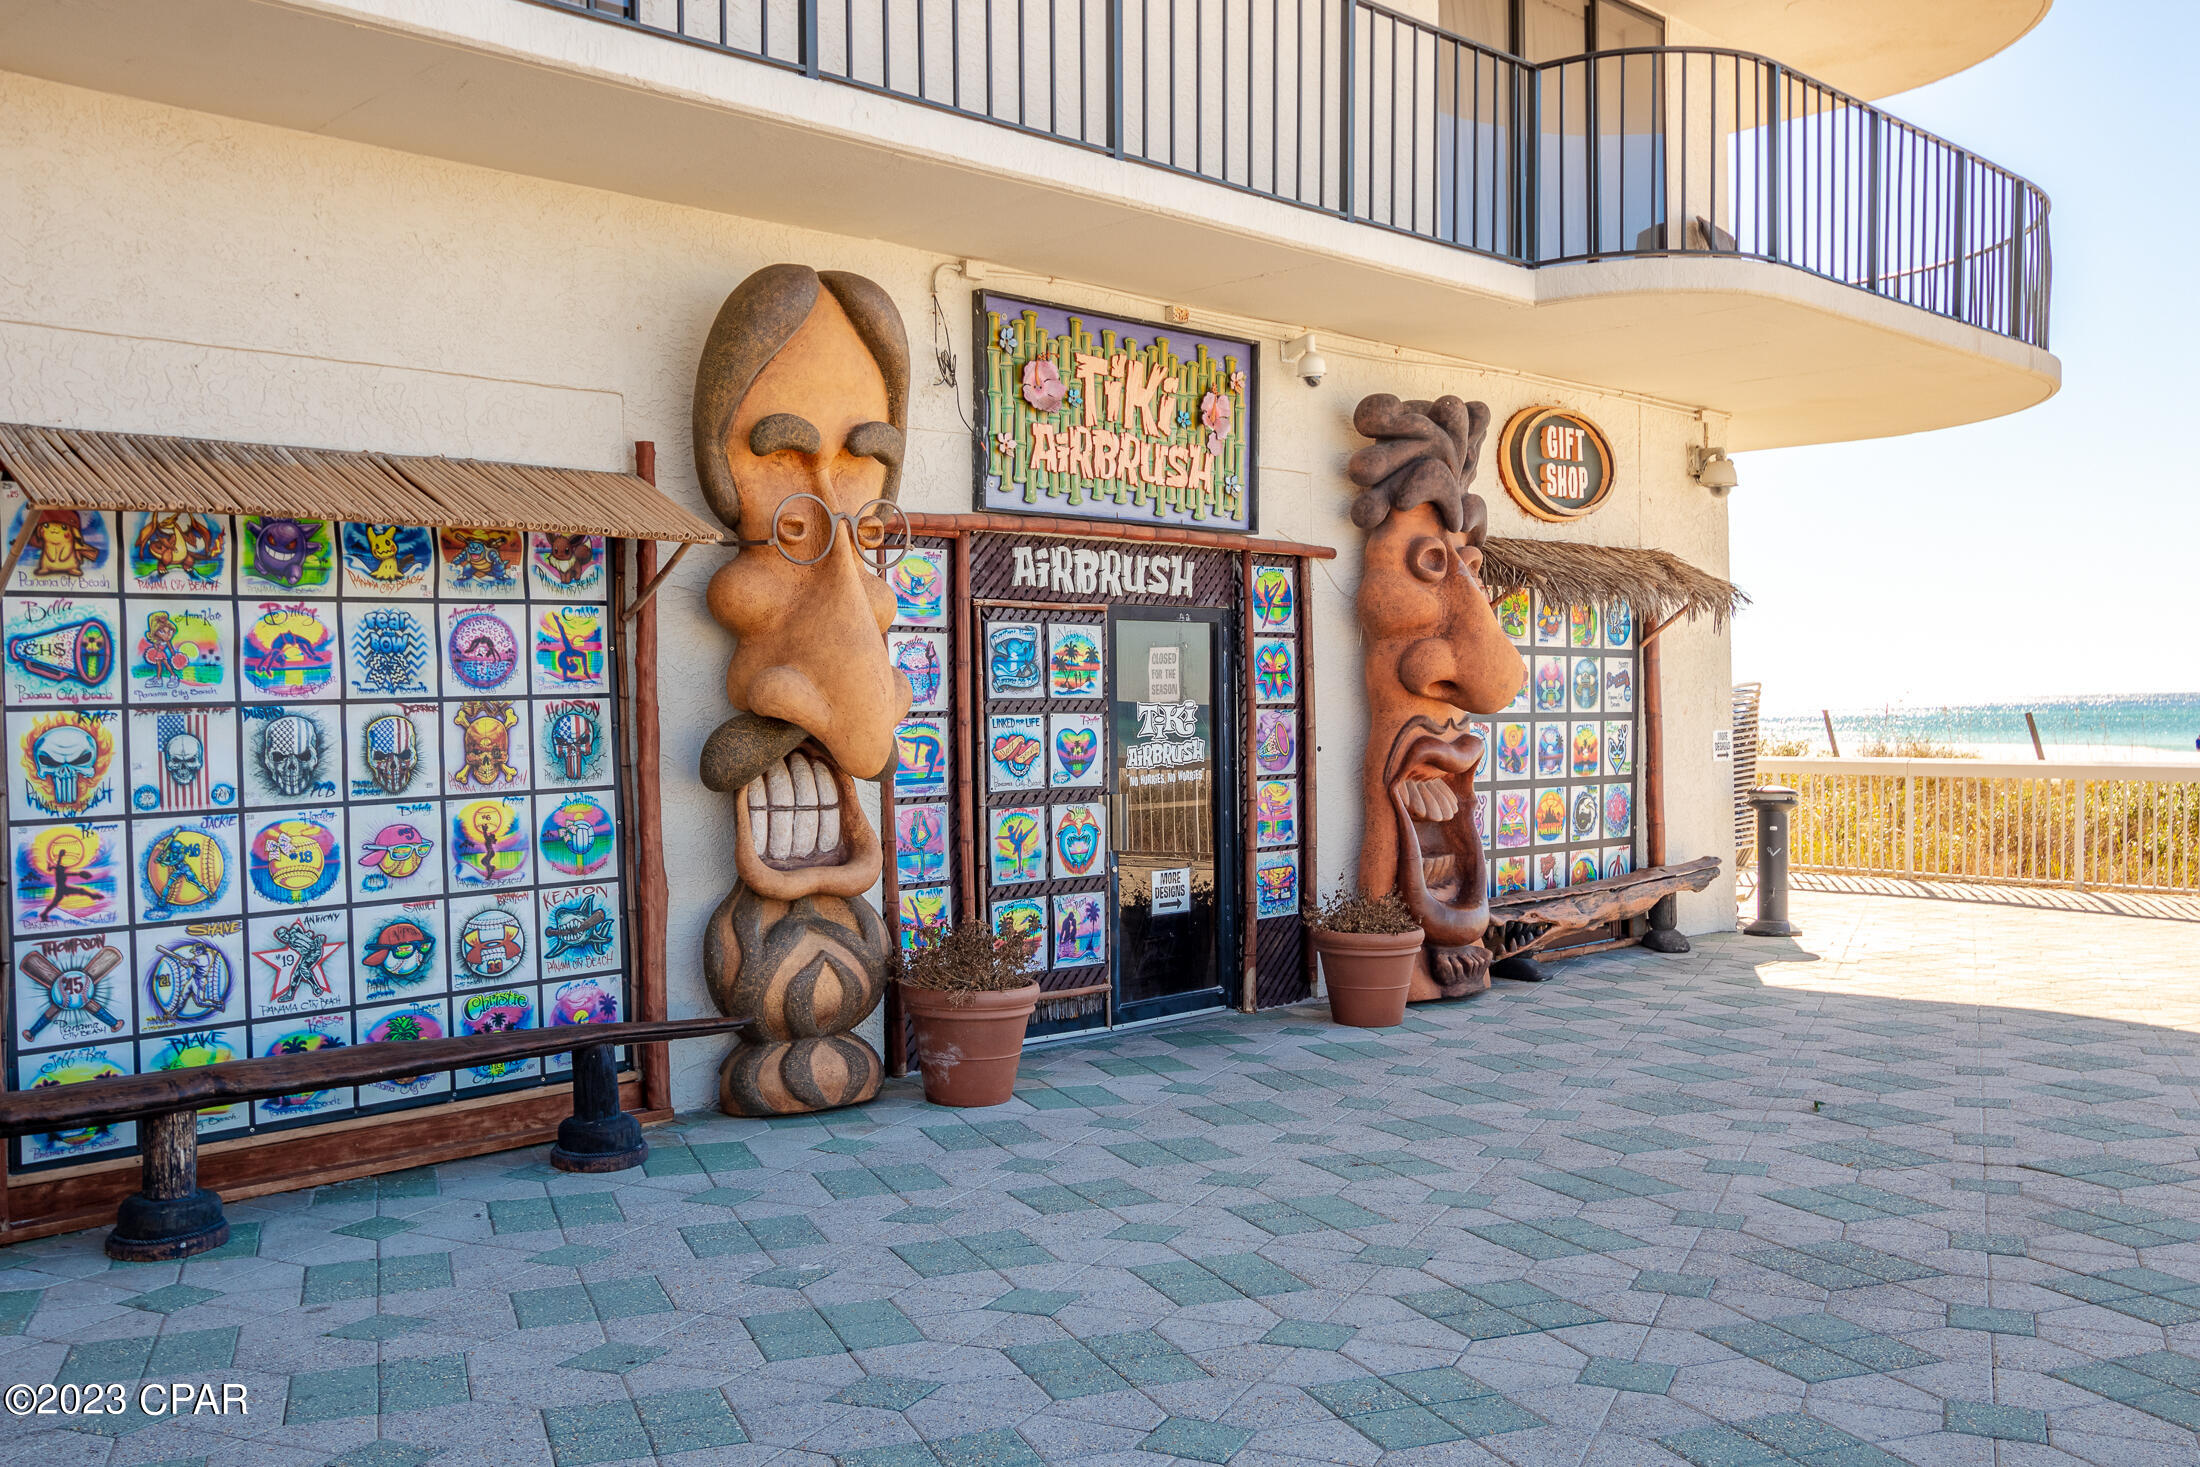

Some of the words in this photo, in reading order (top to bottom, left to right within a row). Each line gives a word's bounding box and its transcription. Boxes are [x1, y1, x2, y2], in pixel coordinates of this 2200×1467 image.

[1543, 424, 1585, 462] GIFT
[1542, 462, 1588, 499] SHOP
[18, 571, 58, 588] Panama
[78, 575, 110, 589] Beach
[23, 641, 66, 656] CHS
[368, 632, 410, 655] BOW
[1151, 652, 1177, 665] CLOSED
[1151, 669, 1163, 680] FOR
[1165, 669, 1176, 680] THE
[1151, 684, 1178, 696] SEASON
[74, 709, 118, 725] RYKER
[545, 699, 600, 722] HUDSON
[992, 717, 1015, 728] LINKED
[1025, 717, 1041, 728] LIFE
[1167, 772, 1177, 783] NO
[310, 781, 336, 798] PCB
[200, 815, 238, 829] JACKIE
[288, 850, 313, 864] #18
[1160, 871, 1181, 885] MORE
[543, 886, 608, 911] KEATON
[1155, 885, 1186, 899] DESIGNS
[303, 912, 340, 928] ANTHONY
[185, 920, 241, 937] SHANE
[32, 933, 106, 960] THOMPSON
[486, 959, 503, 974] 33
[546, 960, 571, 974] PANAMA
[585, 950, 614, 969] BEACH
[259, 1003, 298, 1016] PANAMA
[320, 995, 341, 1009] BEACH
[462, 989, 529, 1021] Christie
[53, 1019, 100, 1035] Panama
[162, 1030, 228, 1056] BLAKE
